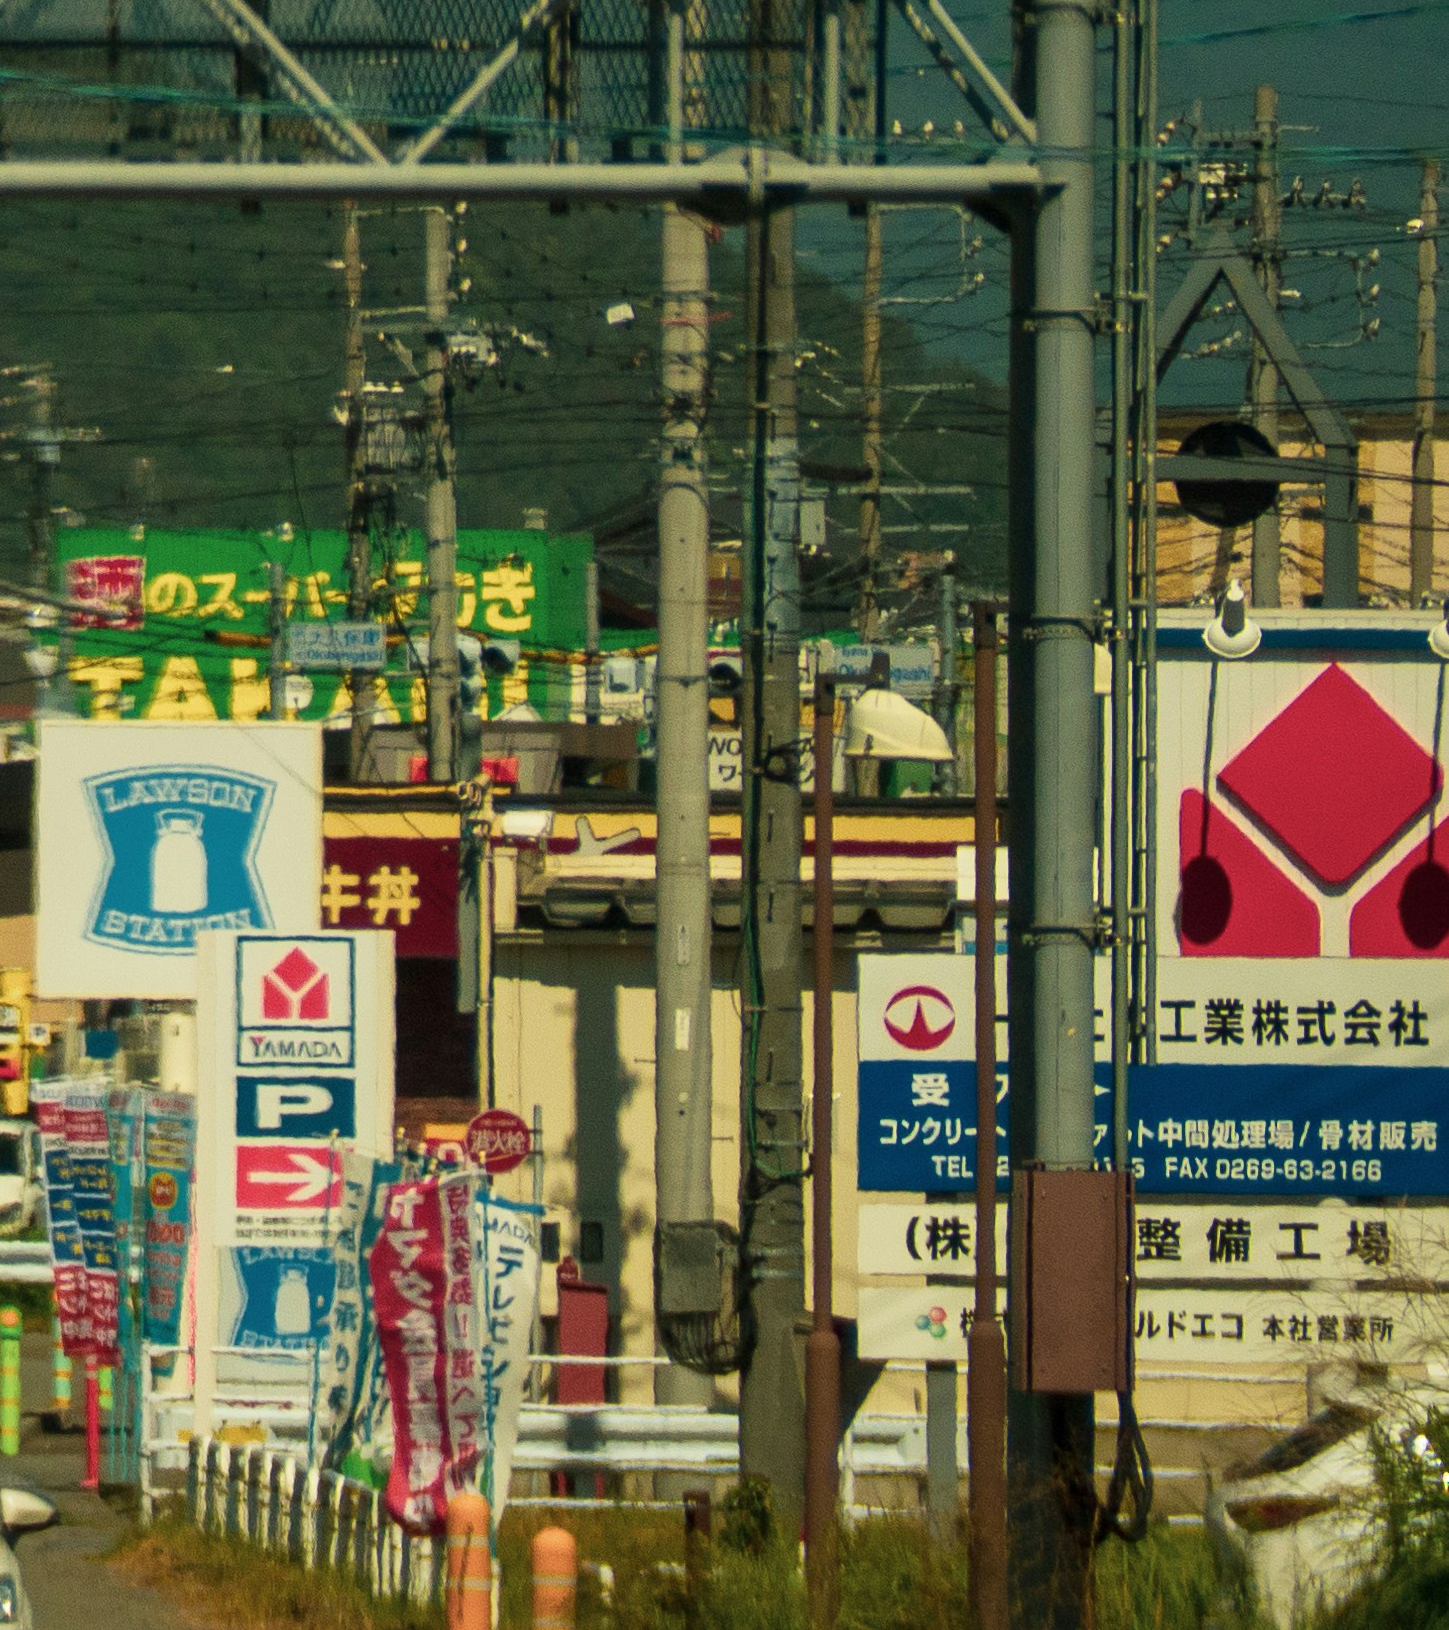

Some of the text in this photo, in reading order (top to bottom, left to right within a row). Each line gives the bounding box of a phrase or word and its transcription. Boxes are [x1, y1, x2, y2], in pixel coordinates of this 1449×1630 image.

[101, 778, 256, 813] LAWSON
[249, 1035, 342, 1059] YAMADA
[254, 1082, 334, 1130] P
[1165, 1157, 1209, 1180] FAX
[1215, 1158, 1383, 1182] 0269-63-2166
